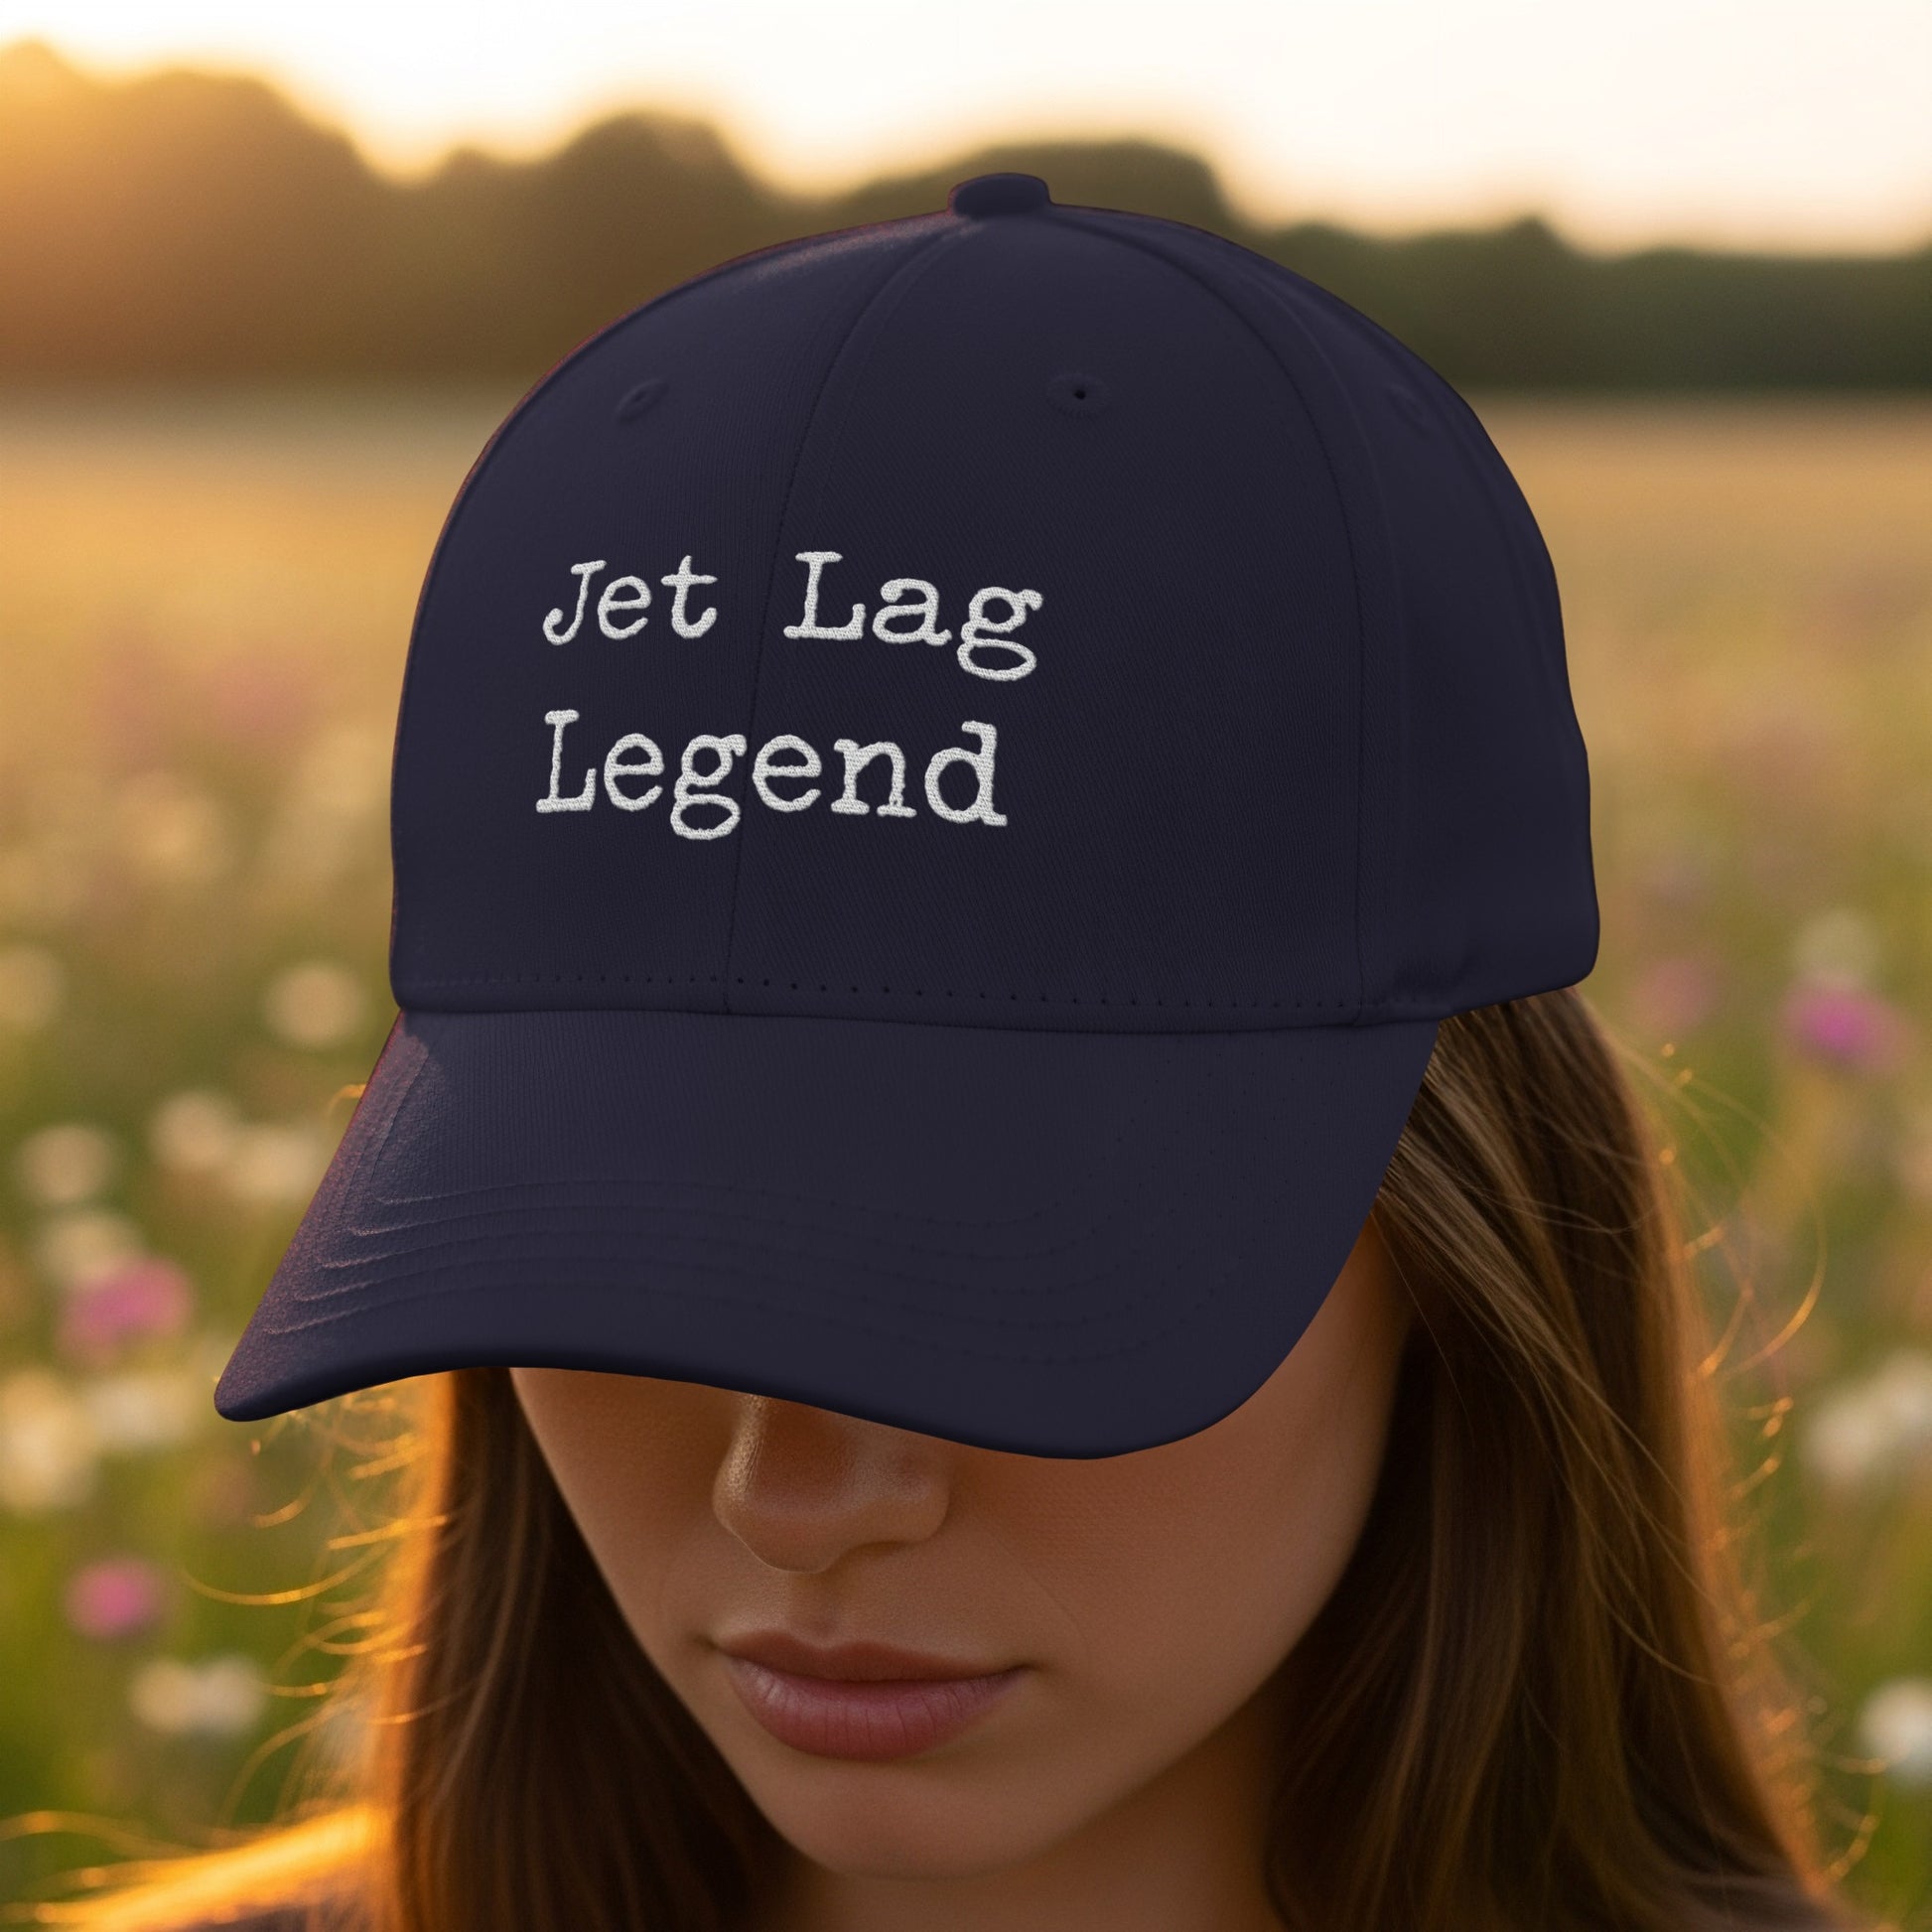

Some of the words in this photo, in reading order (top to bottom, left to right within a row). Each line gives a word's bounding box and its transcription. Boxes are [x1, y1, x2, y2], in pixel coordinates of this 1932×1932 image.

[543, 555, 718, 645] Jet
[783, 551, 1042, 682] Lag
[536, 709, 1008, 841] Legend
